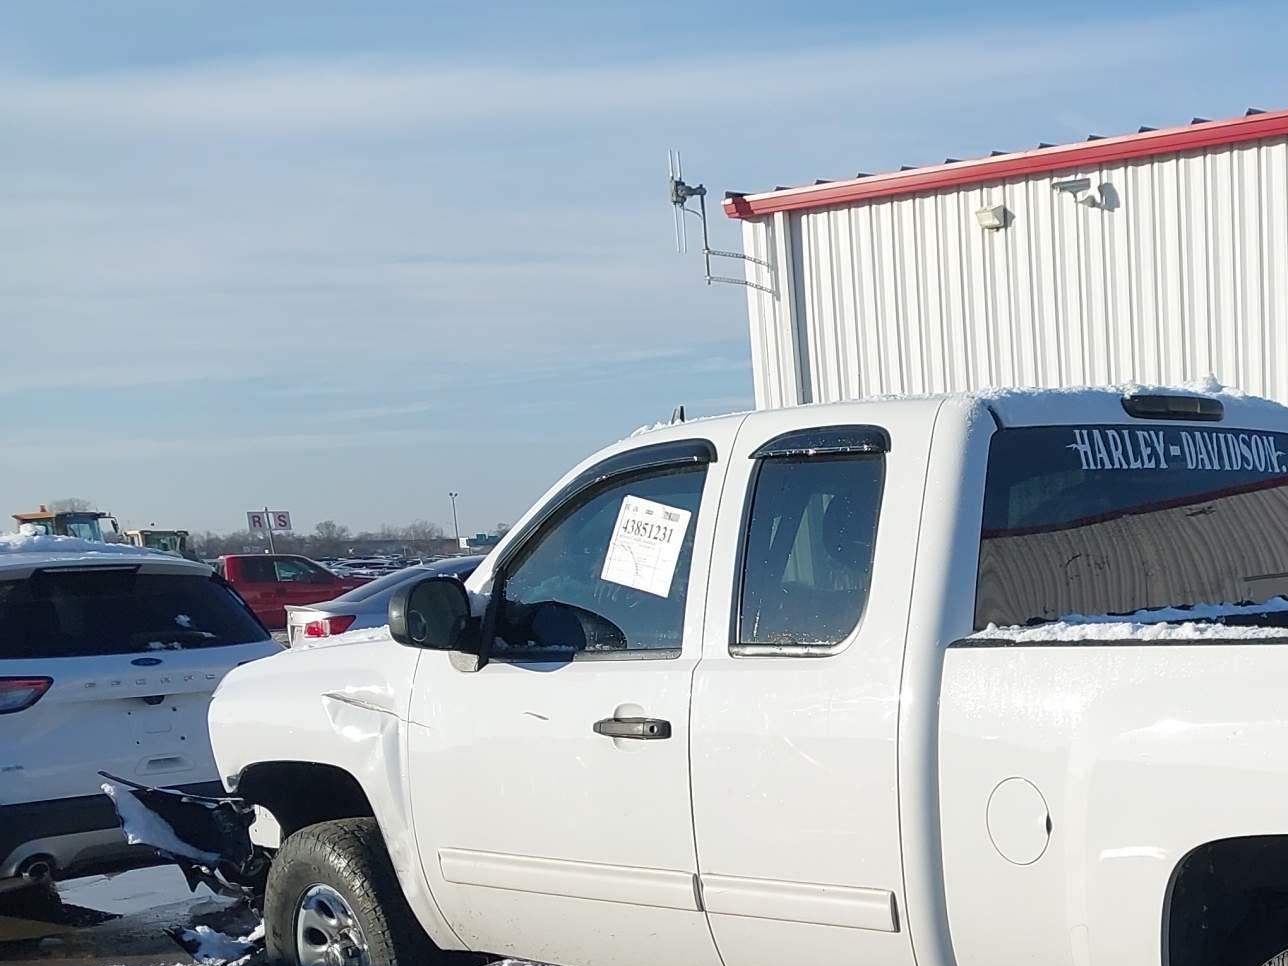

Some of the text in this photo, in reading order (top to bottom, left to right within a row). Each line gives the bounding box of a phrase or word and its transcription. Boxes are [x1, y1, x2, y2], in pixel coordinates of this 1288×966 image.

[251, 514, 288, 528] R S
[621, 518, 674, 544] 43851231
